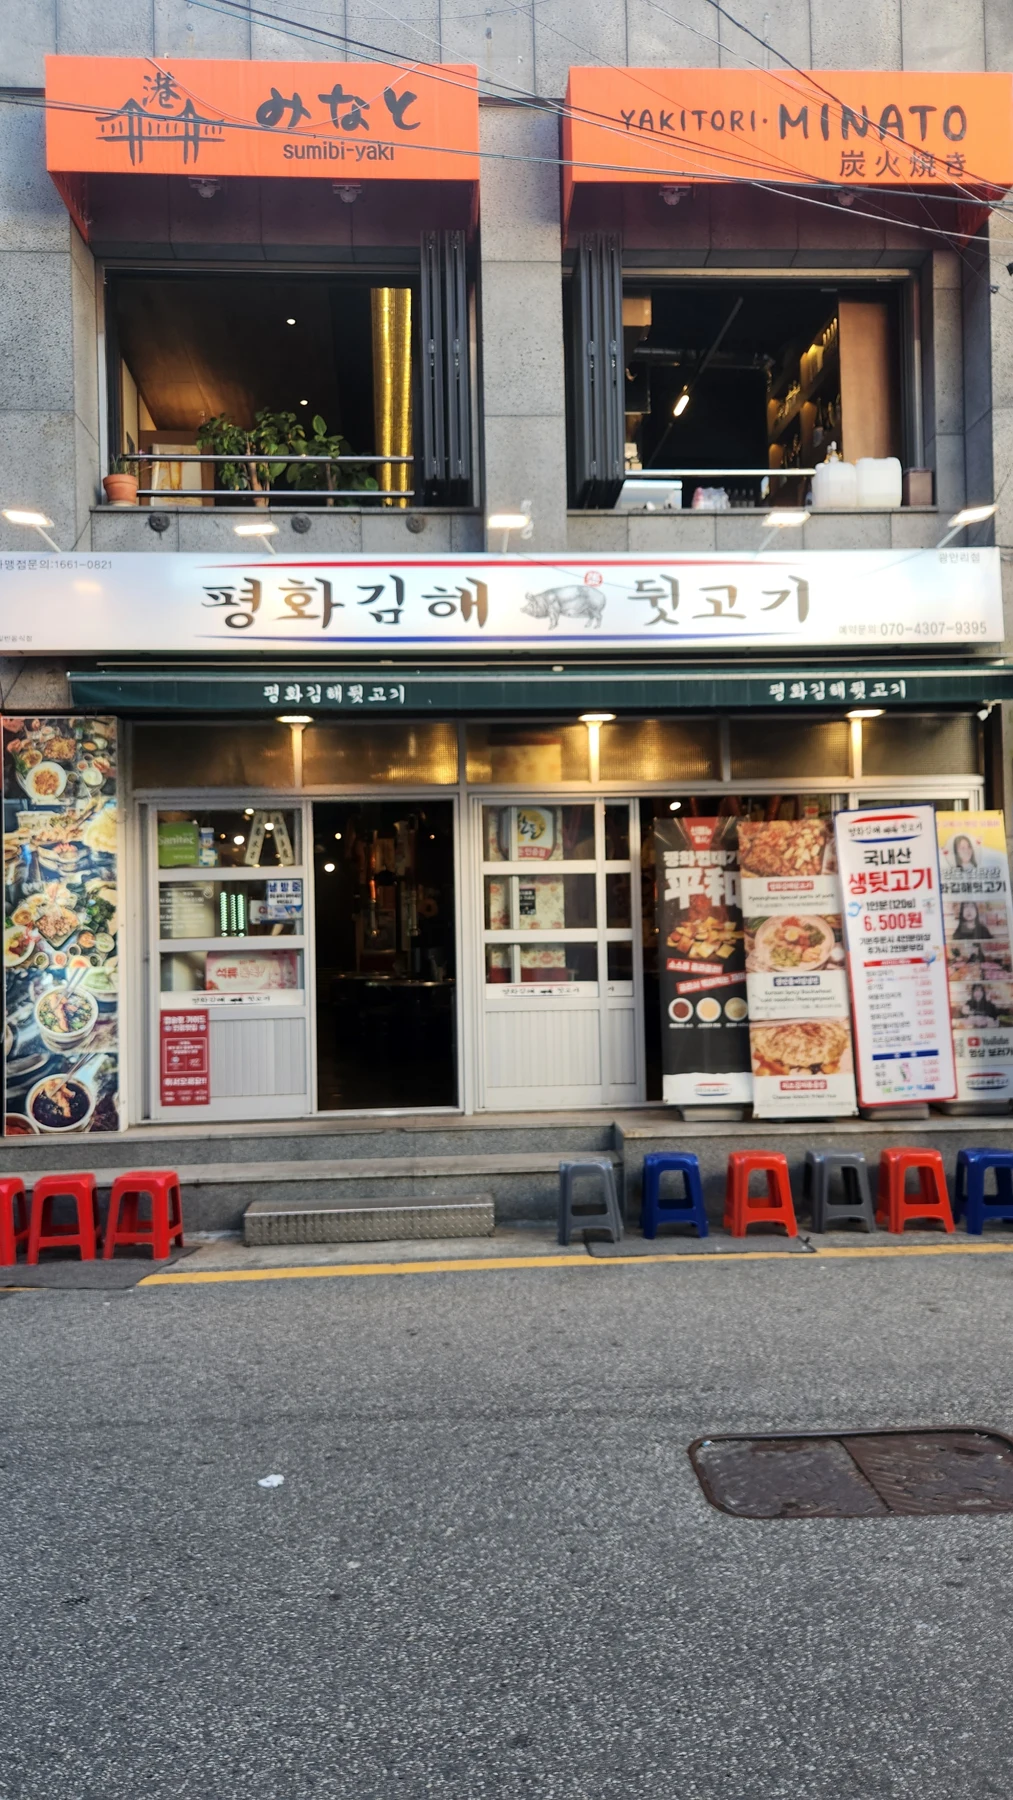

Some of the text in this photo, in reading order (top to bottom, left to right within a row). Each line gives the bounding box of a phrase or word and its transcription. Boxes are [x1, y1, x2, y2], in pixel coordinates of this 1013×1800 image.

[142, 72, 182, 110] 港
[256, 83, 421, 132] みなと
[778, 103, 968, 142] MINATO
[283, 141, 395, 163] sumibi-yaki
[838, 149, 968, 179] 炭火焼き
[201, 573, 810, 630] 평화김해 뒷고기
[880, 621, 988, 636] 070-4307-9395
[262, 683, 406, 705] 평화김해뒷고기
[768, 678, 907, 702] 평화김해뒷고기
[863, 847, 912, 866] 국내산
[664, 867, 741, 911] 平和
[849, 867, 933, 895] 생뒷고기
